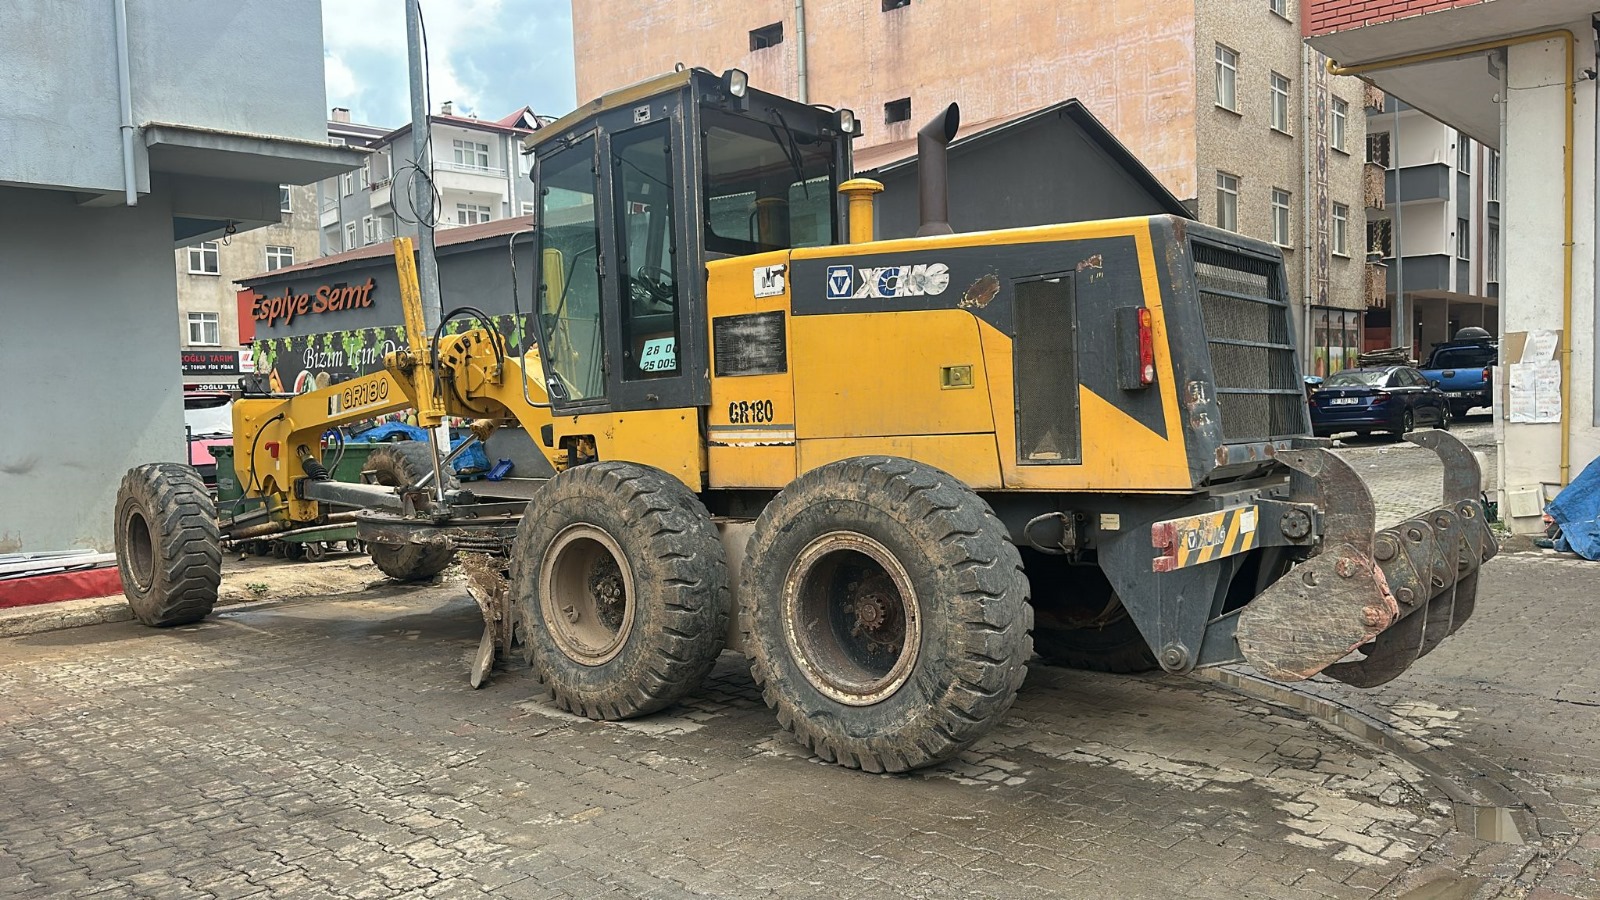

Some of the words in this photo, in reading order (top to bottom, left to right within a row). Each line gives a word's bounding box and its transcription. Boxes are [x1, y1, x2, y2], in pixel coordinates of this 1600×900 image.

[852, 263, 949, 299] XCMG
[251, 287, 309, 327] Espiye
[312, 278, 374, 313] Semt
[209, 354, 234, 363] TARIM
[303, 345, 343, 369] Bizim
[347, 337, 376, 373] İçin
[343, 377, 388, 410] GR180
[728, 400, 774, 424] GR180
